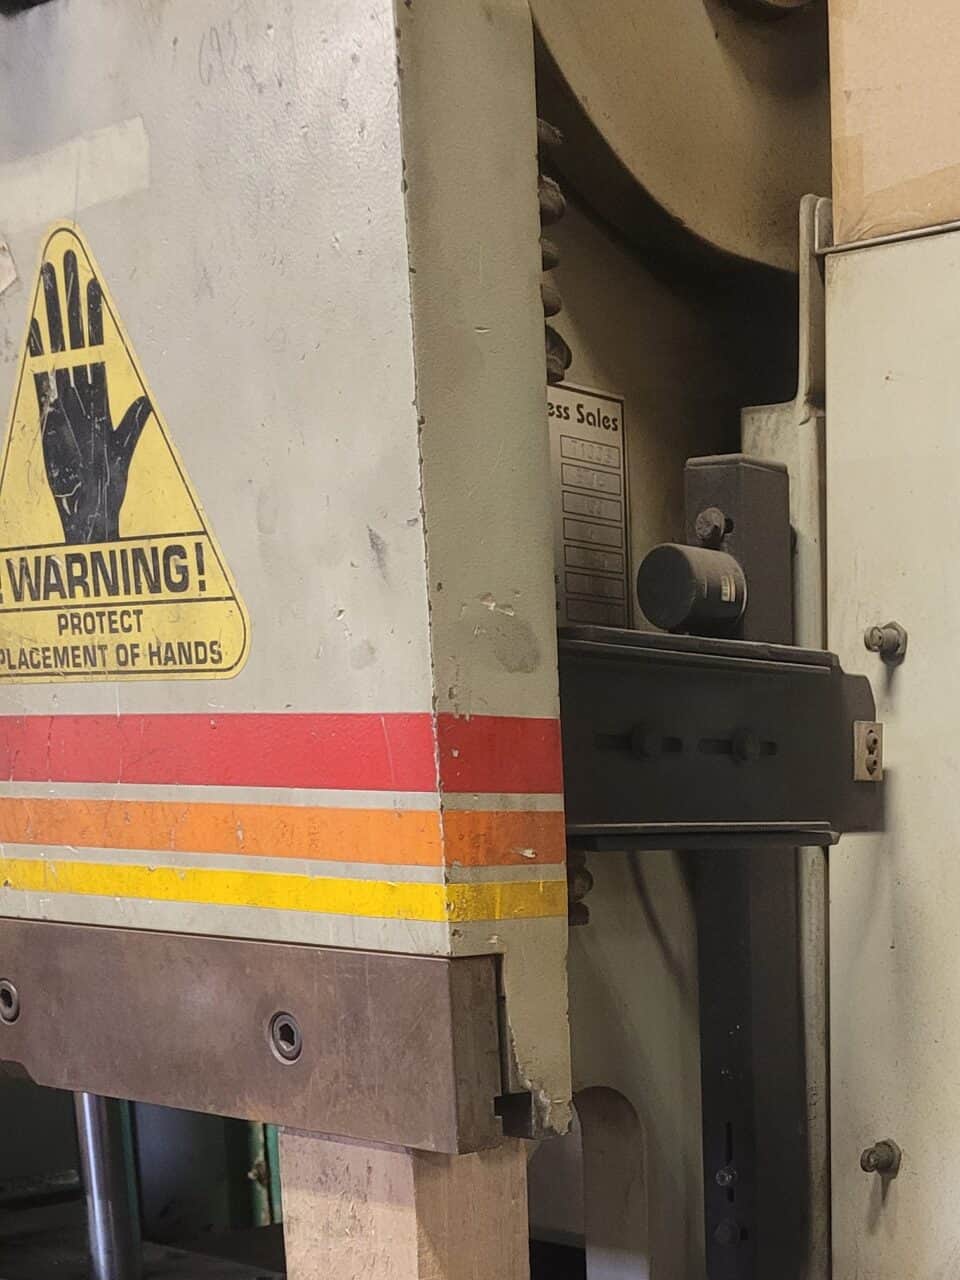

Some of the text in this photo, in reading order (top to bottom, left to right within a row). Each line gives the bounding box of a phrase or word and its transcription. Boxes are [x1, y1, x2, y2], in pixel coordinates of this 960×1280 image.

[576, 404, 619, 431] Sales
[57, 609, 143, 636] PROTECT
[116, 644, 141, 666] OF
[148, 640, 223, 666] HANDS
